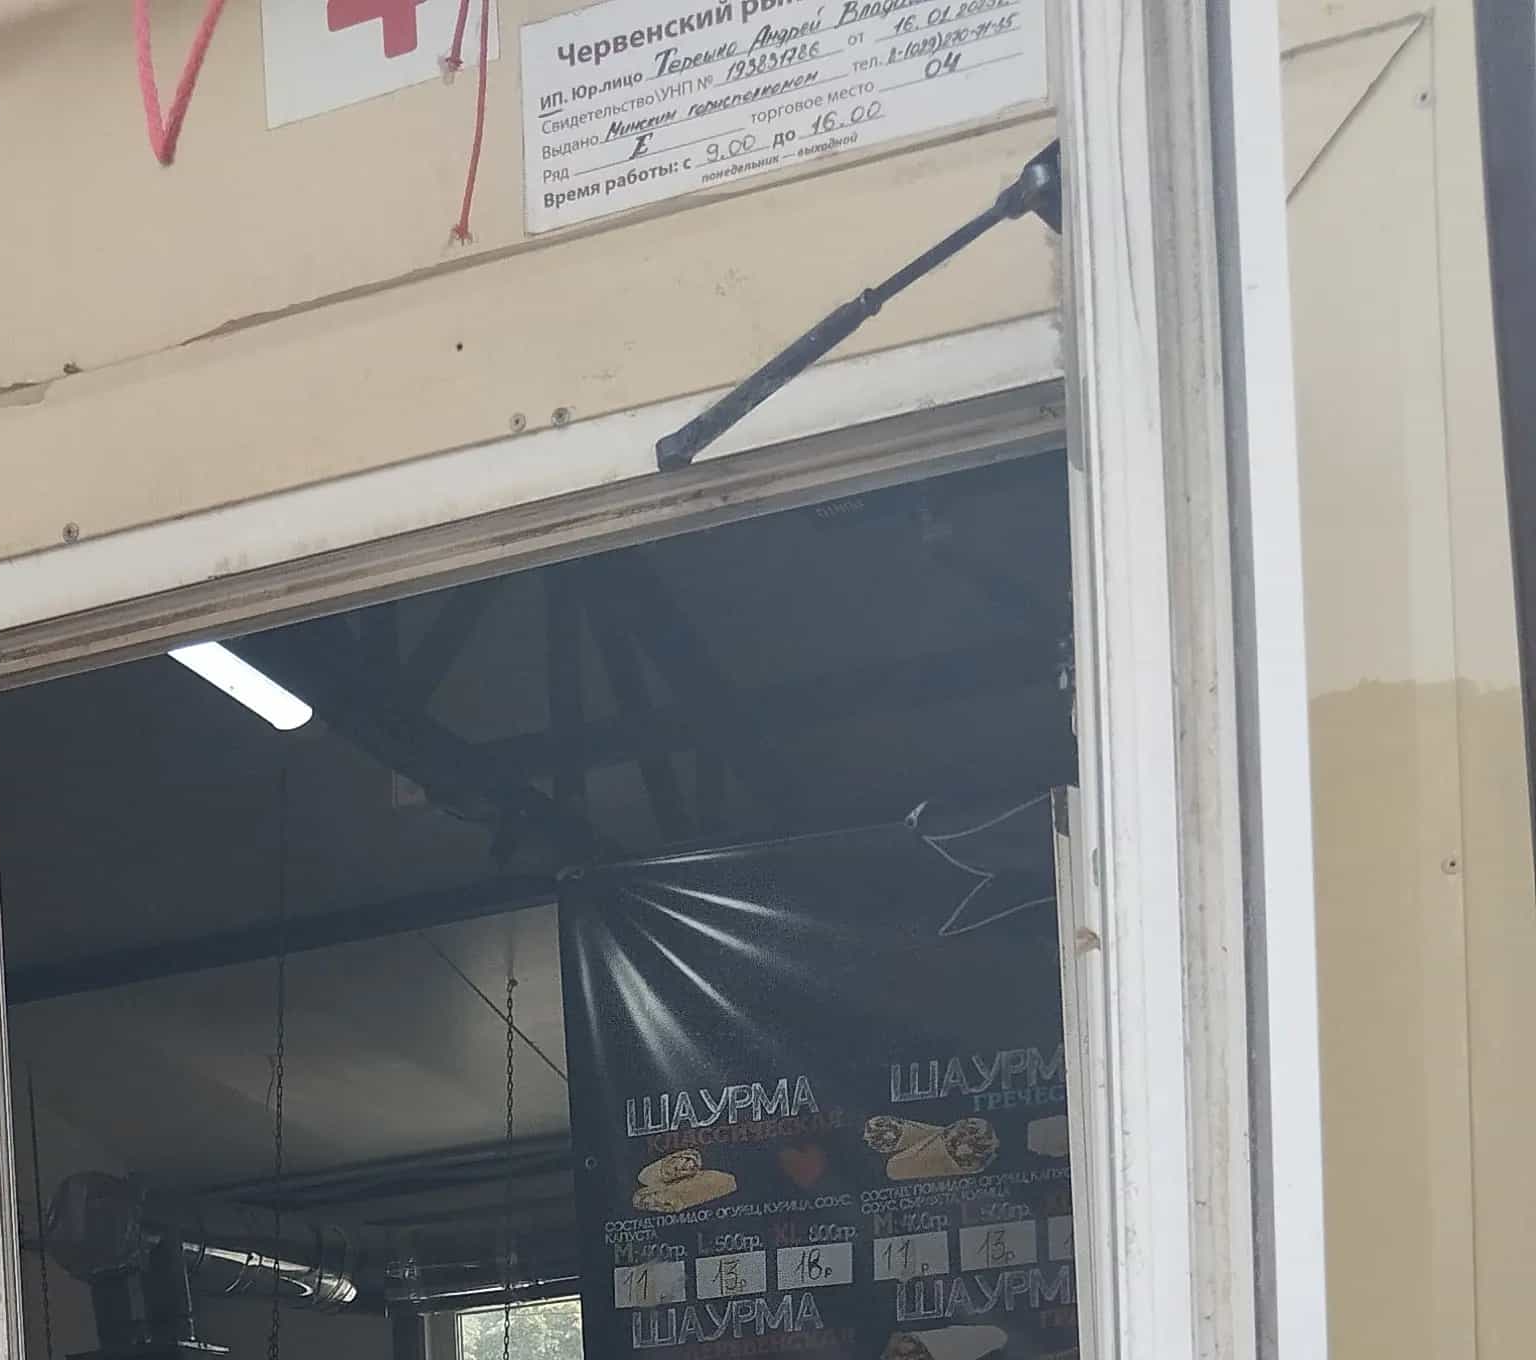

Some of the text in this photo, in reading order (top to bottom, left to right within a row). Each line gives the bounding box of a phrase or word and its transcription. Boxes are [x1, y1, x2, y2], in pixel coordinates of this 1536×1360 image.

[540, 91, 568, 112] ИП.
[571, 72, 643, 99] Юр.лицо
[749, 6, 824, 57] Андрей
[557, 0, 732, 66] Червенский
[848, 32, 865, 46] от
[542, 135, 600, 160] Выдано
[852, 55, 883, 73] тел.
[543, 167, 570, 183] Ряд
[751, 96, 824, 124] торговое
[827, 81, 875, 105] место
[543, 100, 883, 209] Время работы: с 9.00 до 16.00
[701, 132, 859, 184] понедельник выходной
[625, 1074, 820, 1137] ШАУРМА
[890, 1047, 1066, 1102] ШАУРМ
[631, 1292, 825, 1349] ШАУРМА
[896, 1266, 1076, 1322] ШАУРМ
